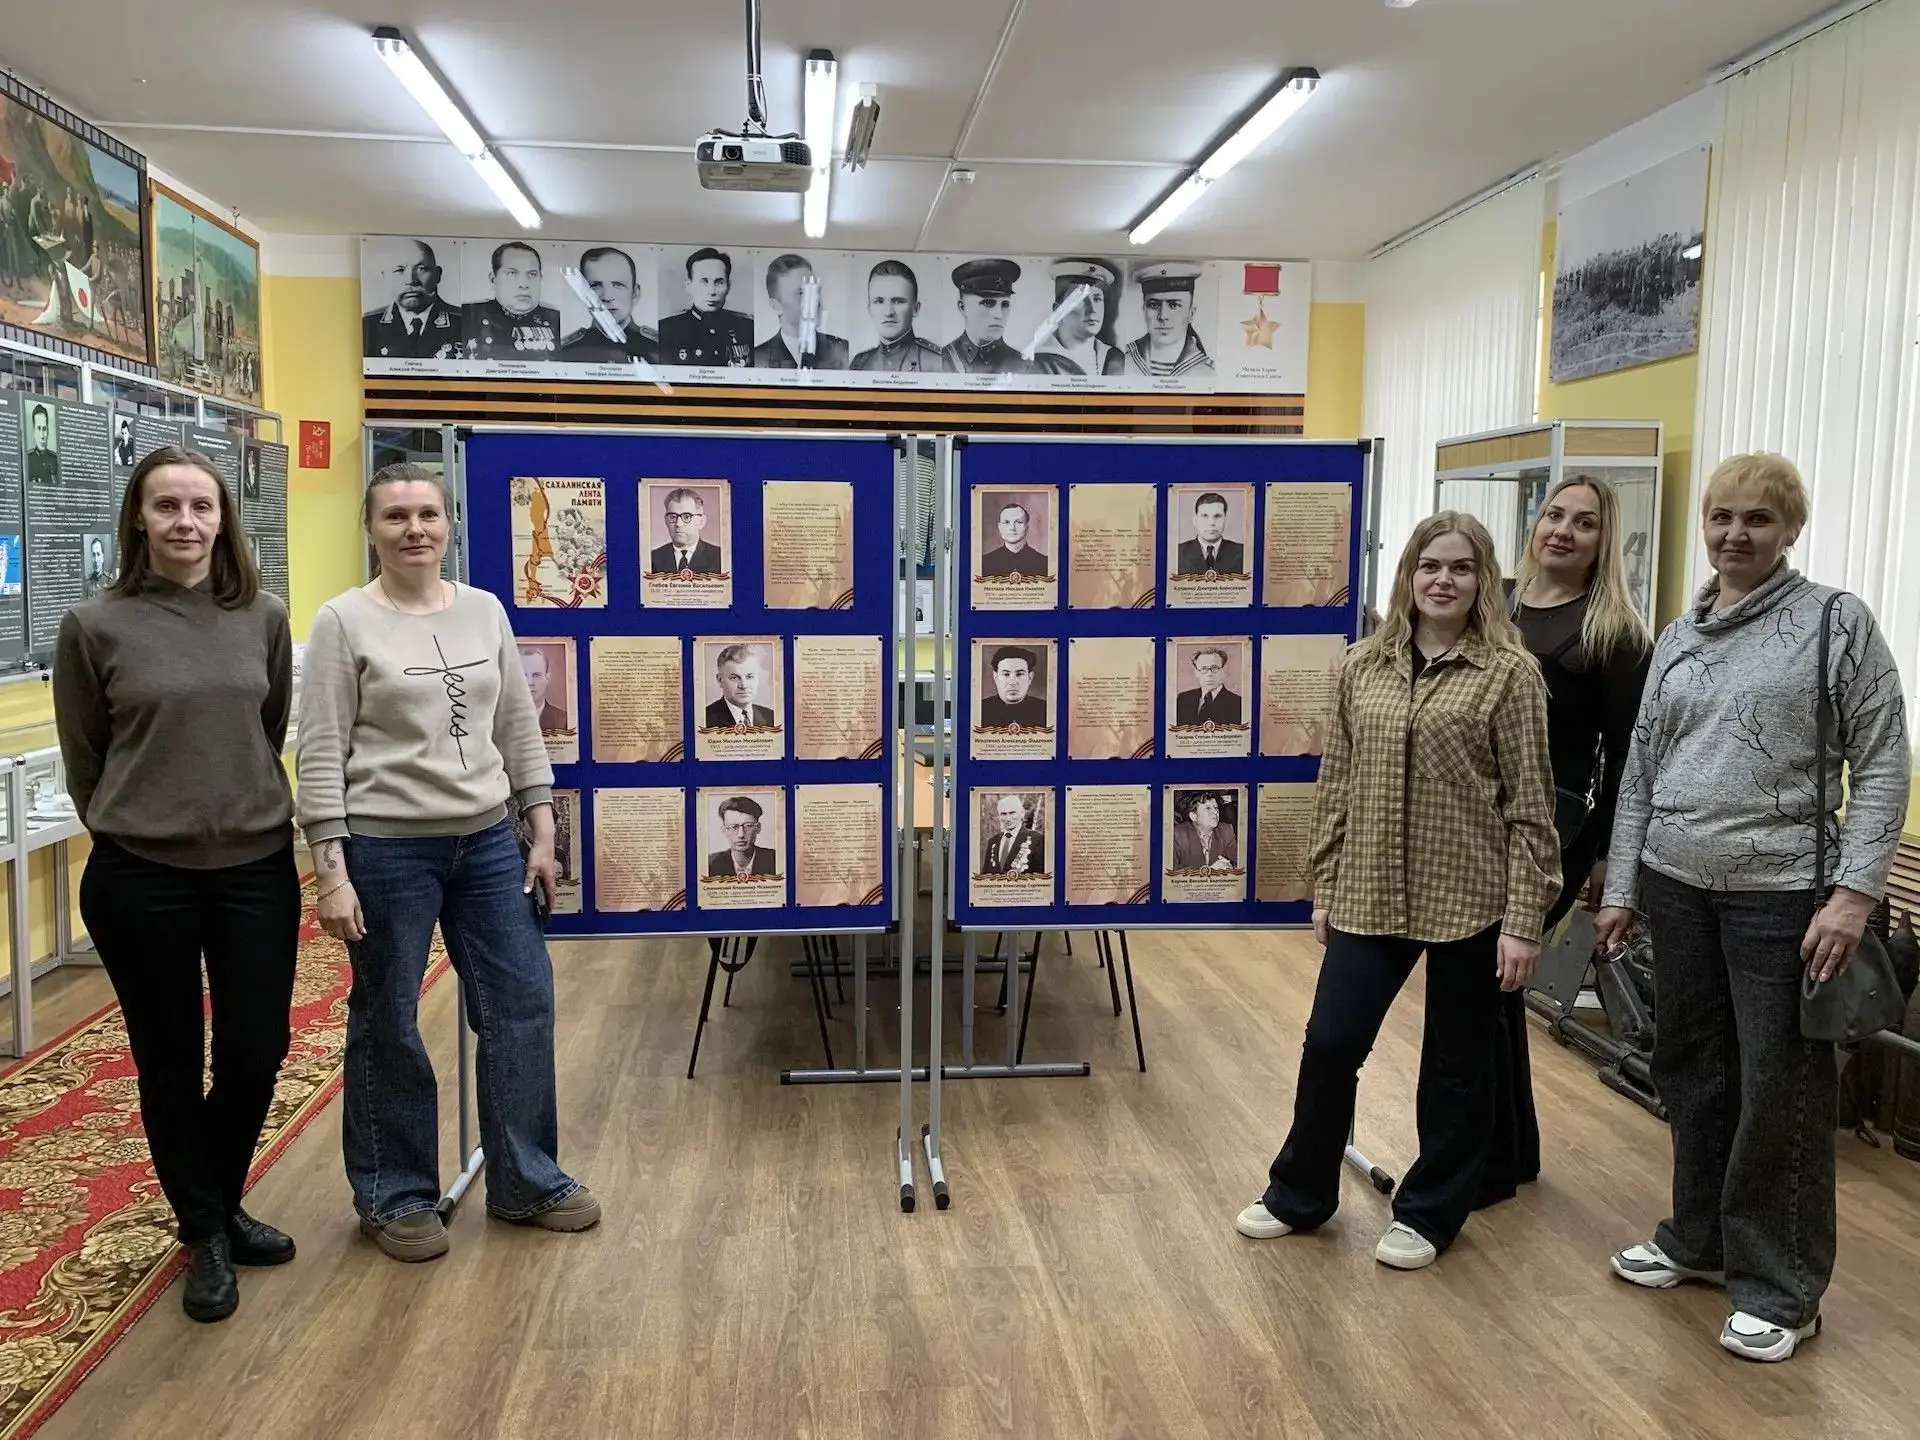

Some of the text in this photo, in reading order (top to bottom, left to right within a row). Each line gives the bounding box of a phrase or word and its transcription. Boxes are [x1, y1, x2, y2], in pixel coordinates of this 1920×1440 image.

[545, 481, 602, 489] САХАЛИНСКАЯ
[579, 490, 602, 498] ЛЕНТА
[571, 498, 602, 507] ПАМЯТИ
[403, 634, 489, 770] Jesus
